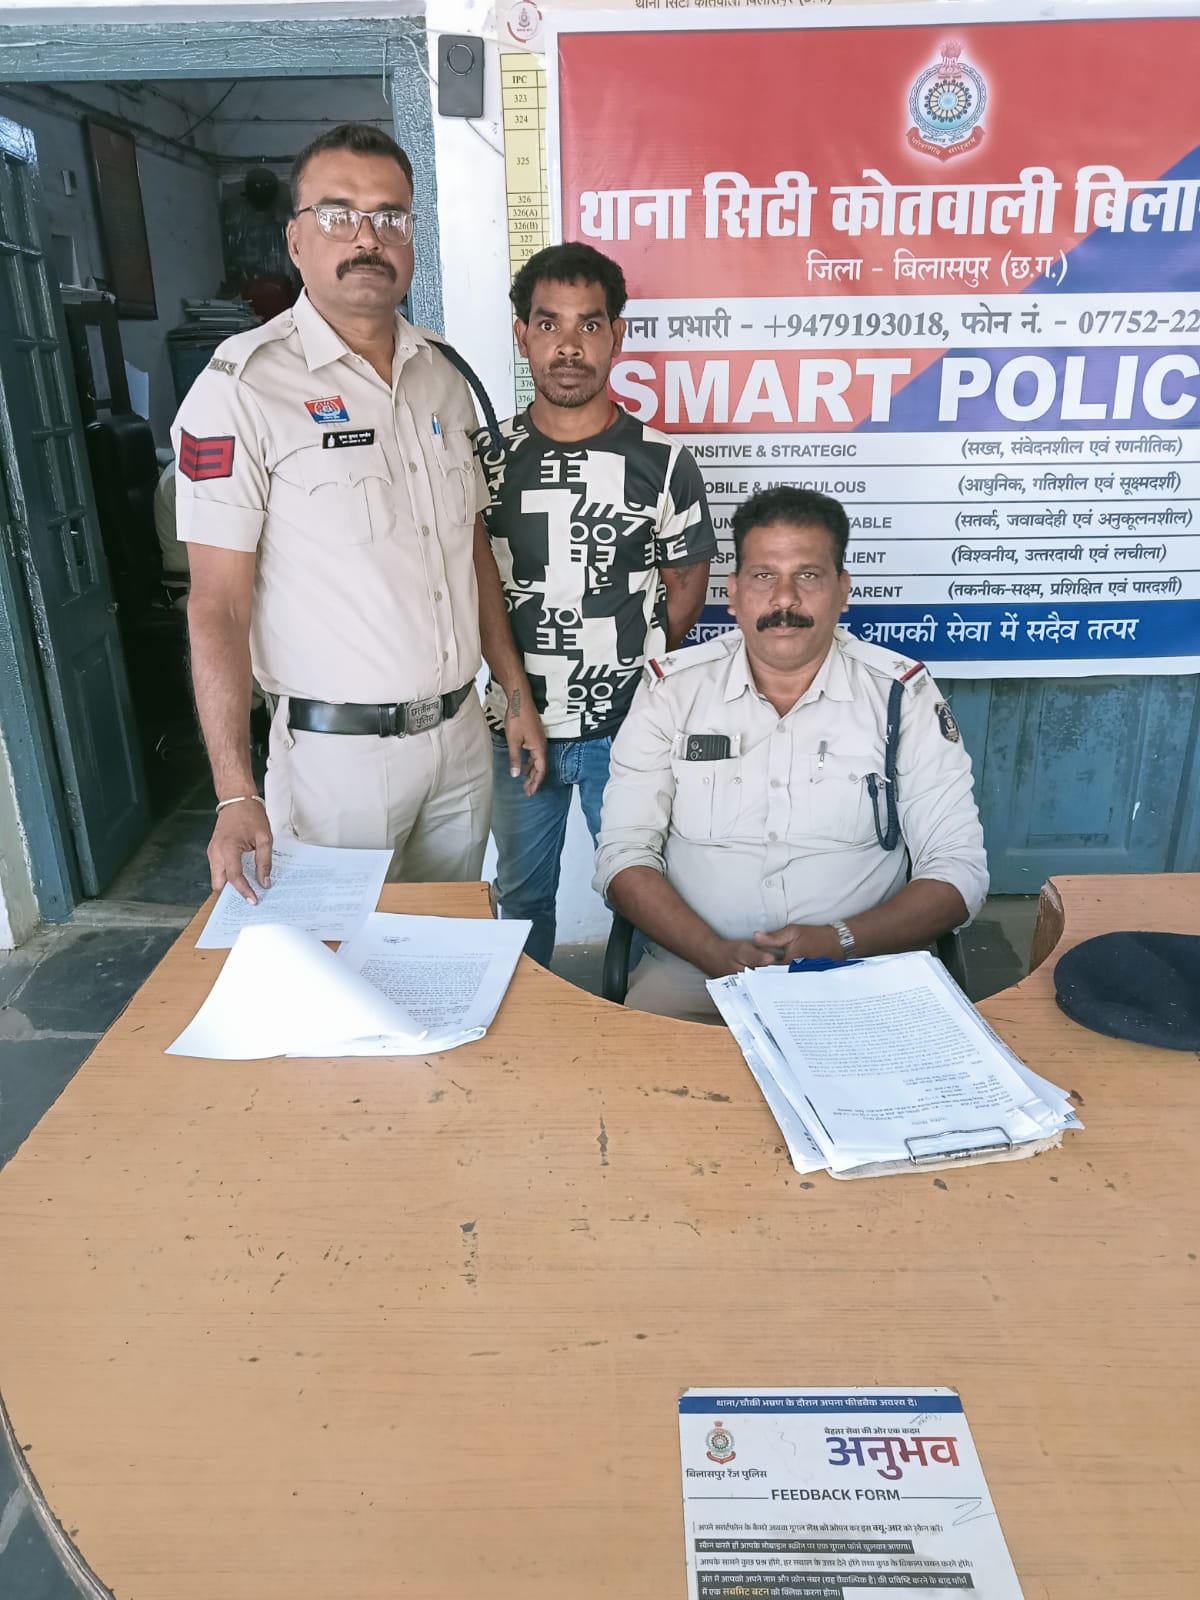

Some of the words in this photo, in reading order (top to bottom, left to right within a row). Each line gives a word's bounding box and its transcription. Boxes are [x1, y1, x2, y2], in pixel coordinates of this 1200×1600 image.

[512, 76, 527, 84] IPC
[514, 94, 528, 103] 323
[515, 115, 528, 124] 324
[516, 157, 530, 166] 325
[517, 196, 532, 204] 326
[580, 188, 692, 241] थाना
[703, 170, 817, 239] सिटी
[830, 166, 1062, 237] कोतवाली
[1073, 165, 1200, 234] बिला
[513, 208, 538, 218] 326(A)
[514, 221, 538, 231] 326(B)
[519, 235, 533, 243] 327
[806, 249, 863, 282] जिला
[894, 248, 991, 288] बिलासपुर
[1001, 249, 1067, 287] (छ.ग.)
[624, 317, 658, 339] ाना
[668, 307, 731, 338] प्रभारी
[764, 312, 949, 341] +9479193018,
[961, 302, 1012, 335] फोन
[1020, 302, 1042, 335] नं.
[1078, 309, 1200, 334] 07752-22
[609, 358, 911, 424] SMART
[938, 354, 1200, 422] POLIC
[688, 445, 752, 458] NSITIVE
[756, 445, 768, 458] &
[770, 444, 857, 458] STRATEGIC
[961, 438, 1005, 459] (सख्त,
[1011, 436, 1084, 457] संवेदनशील
[1089, 436, 1109, 457] एवं
[1115, 434, 1183, 456] रणनीतिक)
[704, 481, 748, 494] OBILE
[752, 481, 763, 493] &
[958, 472, 1026, 496] (आधुनिक,
[1032, 472, 1089, 492] गतिशील
[1094, 472, 1115, 493] एवं
[1119, 471, 1182, 496] सूक्ष्मदर्शी)
[849, 517, 892, 529] ABLE
[954, 508, 1000, 531] (सतर्क,
[1007, 508, 1068, 528] जवाबदेही
[1073, 508, 1093, 529] एवं
[1098, 507, 1193, 531] अनुकूलनशील)
[844, 552, 886, 564] LIENT
[951, 545, 1019, 566] (विश्वनीय,
[1025, 544, 1084, 562] उत्तरदायी
[1089, 544, 1109, 563] एवं
[1114, 543, 1167, 562] लचीला)
[848, 586, 903, 598] ARENT
[1050, 577, 1104, 597] प्रशिक्षित
[1108, 577, 1128, 598] एवं
[1132, 575, 1182, 597] पारदर्शी)
[860, 614, 938, 644] आपकी
[946, 612, 992, 644] सेवा
[1000, 612, 1020, 642] में
[1027, 611, 1079, 644] सदैव
[1087, 618, 1139, 641] तत्पर
[786, 1397, 795, 1408] के
[797, 1397, 818, 1408] दौरान
[820, 1397, 844, 1408] अपना
[846, 1397, 877, 1408] फीडबैक
[880, 1397, 906, 1408] अवश्य
[846, 1427, 860, 1435] सेवा
[862, 1427, 872, 1435] की
[873, 1427, 886, 1435] ओर
[887, 1427, 900, 1435] एक
[902, 1427, 920, 1435] कदम
[826, 1436, 960, 1480] अनुभव
[686, 1468, 726, 1480] बिलासपुर
[727, 1468, 740, 1478] रेंज
[741, 1468, 767, 1480] पुलिस
[771, 1488, 851, 1501] FEEDBACK
[855, 1488, 900, 1501] FORM
